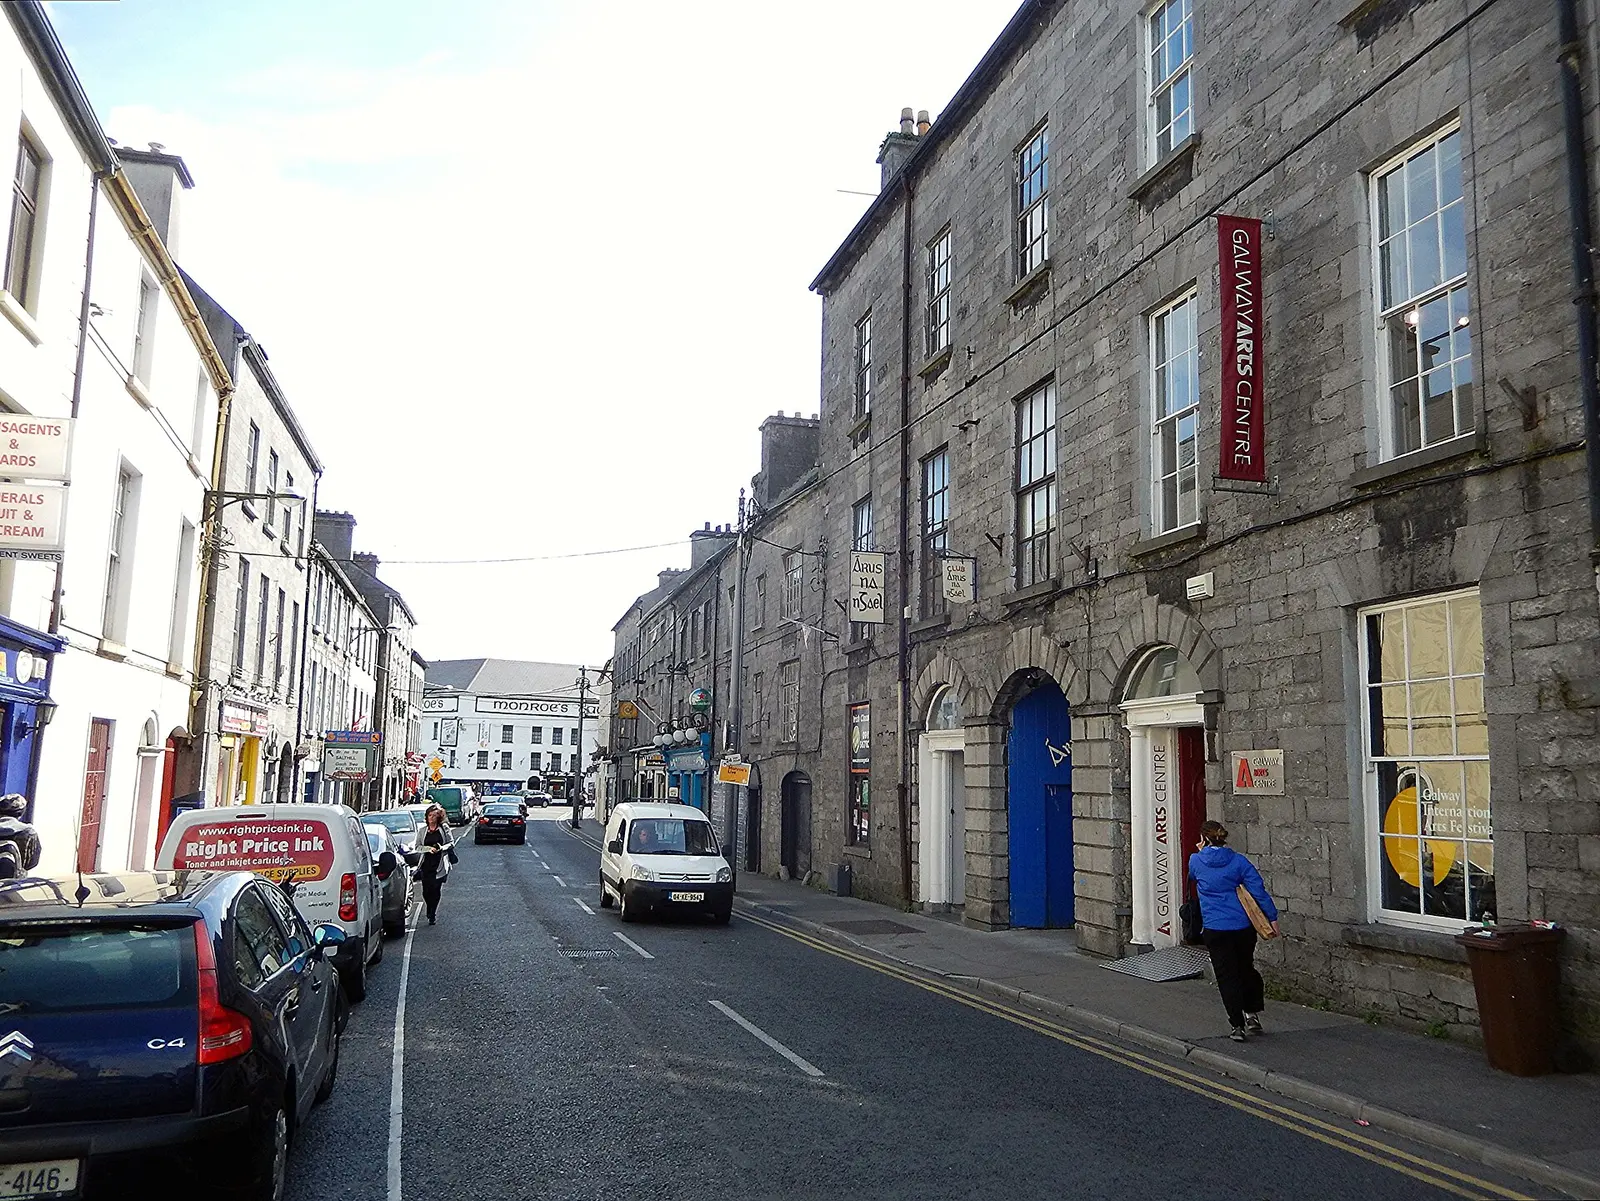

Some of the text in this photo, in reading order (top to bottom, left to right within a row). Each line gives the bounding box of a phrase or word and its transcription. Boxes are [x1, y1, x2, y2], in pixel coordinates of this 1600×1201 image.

[1232, 229, 1254, 465] GALWAY ARTS CENTRE
[0, 421, 61, 436] SAGENTS
[9, 438, 19, 450] &
[23, 509, 34, 521] &
[20, 551, 62, 561] SWEETS
[1253, 757, 1279, 766] GALWAY
[1254, 779, 1277, 788] CENTRE
[1422, 788, 1461, 805] Galway
[199, 823, 314, 837] www.rightpriceink.ie
[1153, 745, 1169, 917] GALWAY ARTS CENTRE
[1424, 820, 1447, 832] Arts
[185, 836, 325, 860] Right Price Ink
[185, 859, 209, 869] Toner
[210, 858, 225, 868] and
[227, 856, 251, 868] inkjet
[276, 866, 317, 878] SUPPLIES
[147, 1037, 186, 1050] C4
